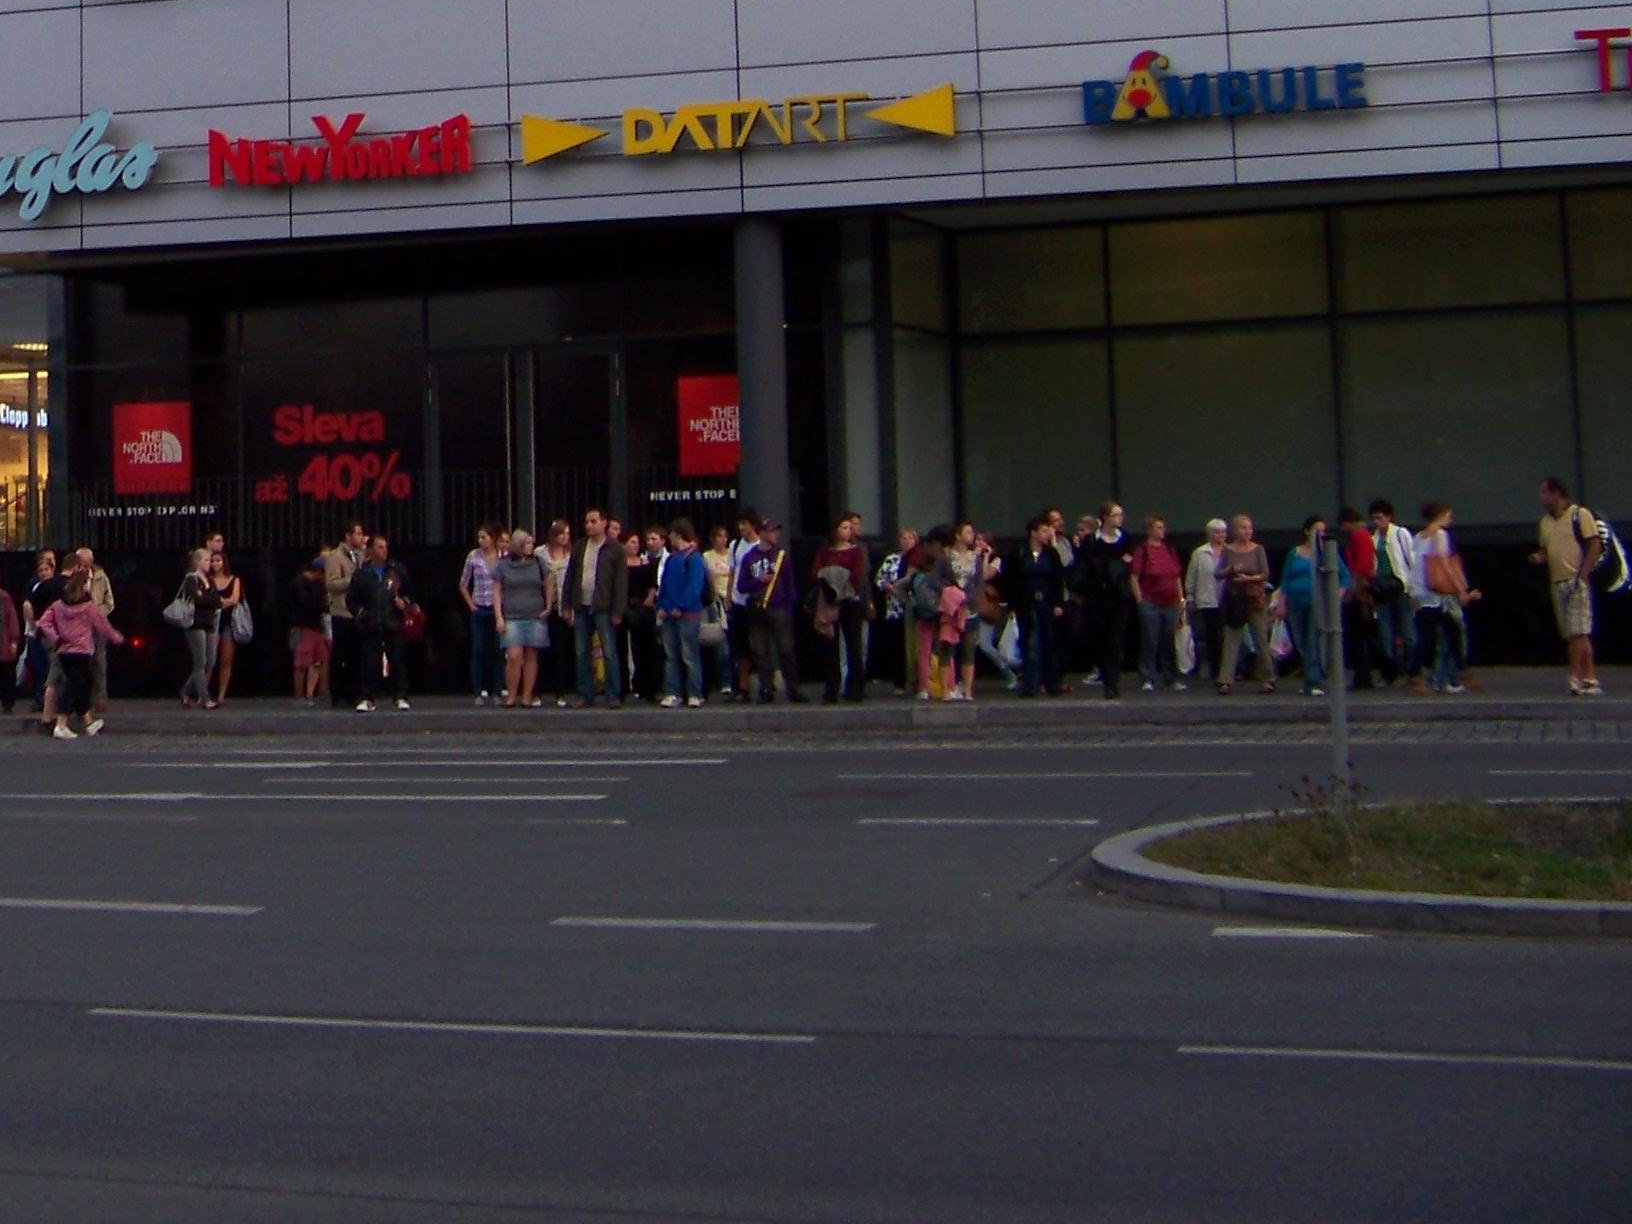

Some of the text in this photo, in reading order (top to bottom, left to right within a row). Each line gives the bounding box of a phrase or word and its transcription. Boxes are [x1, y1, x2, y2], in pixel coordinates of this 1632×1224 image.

[1083, 52, 1368, 126] BAMBULE
[623, 92, 869, 156] DATART
[709, 406, 735, 419] THE
[274, 404, 385, 445] Sleva
[689, 419, 735, 432] NORTH
[140, 430, 162, 441] THE
[703, 431, 735, 443] FACE
[122, 442, 162, 453] NORTH
[133, 452, 162, 464] FACE
[298, 450, 412, 502] 40%
[649, 490, 691, 501] NEVER
[695, 489, 725, 500] STOP
